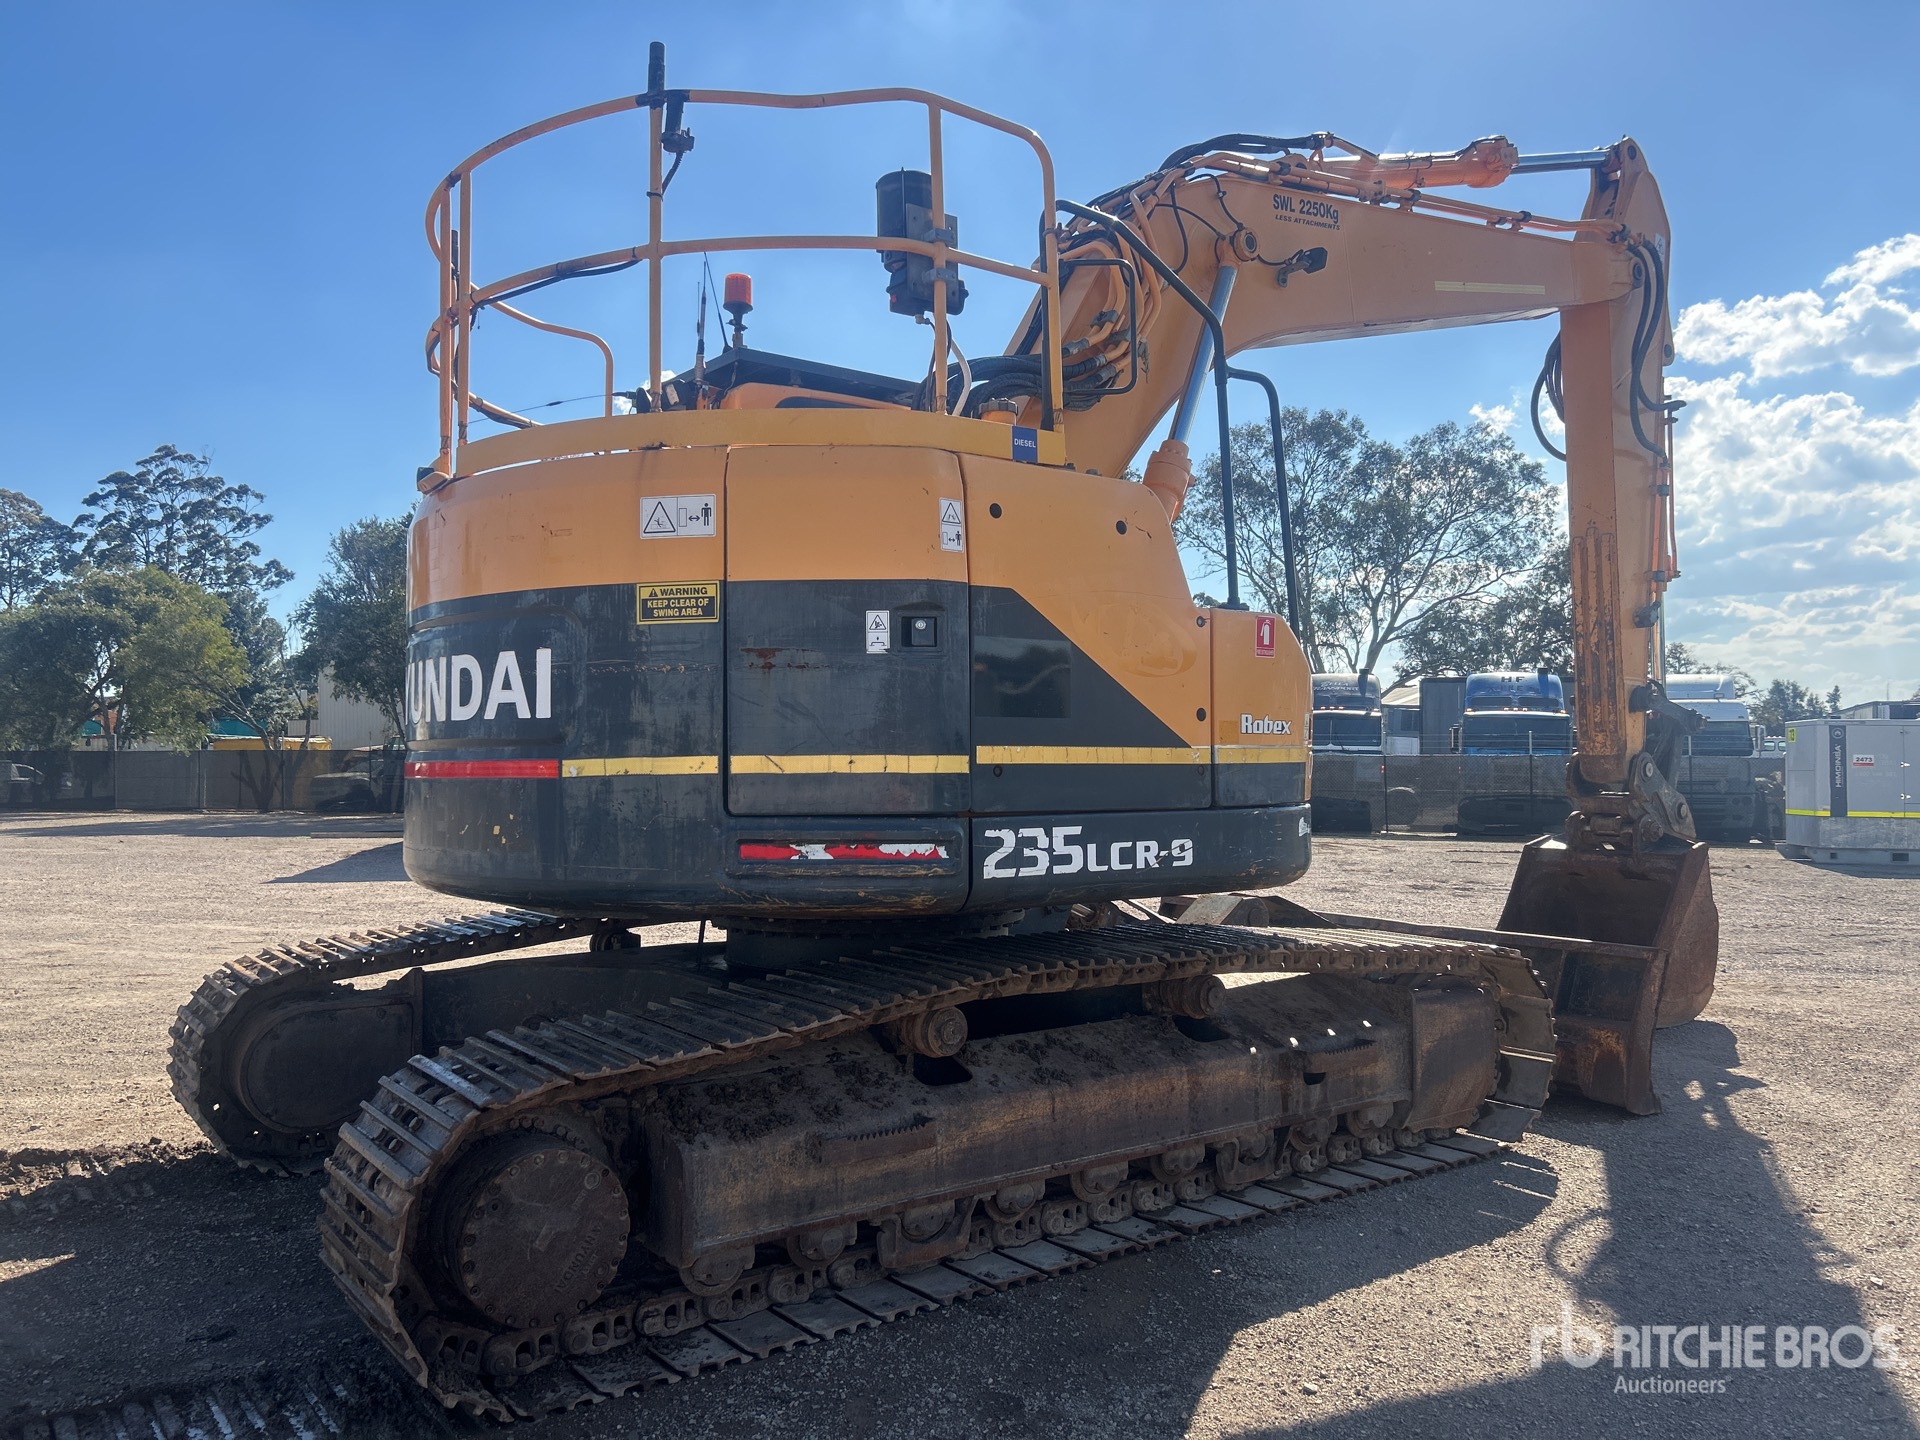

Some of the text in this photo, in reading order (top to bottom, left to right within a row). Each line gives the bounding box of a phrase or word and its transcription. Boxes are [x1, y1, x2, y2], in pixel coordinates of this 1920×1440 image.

[1273, 193, 1339, 224] SWL 2250Kg
[1275, 214, 1340, 230] LESS ATTACHMENTS
[1014, 438, 1036, 447] DIESEL
[660, 587, 708, 596] WARNING
[647, 598, 709, 608] KEEP CLEAR OF
[653, 607, 703, 617] SWING AREA
[1241, 713, 1292, 735] Robex
